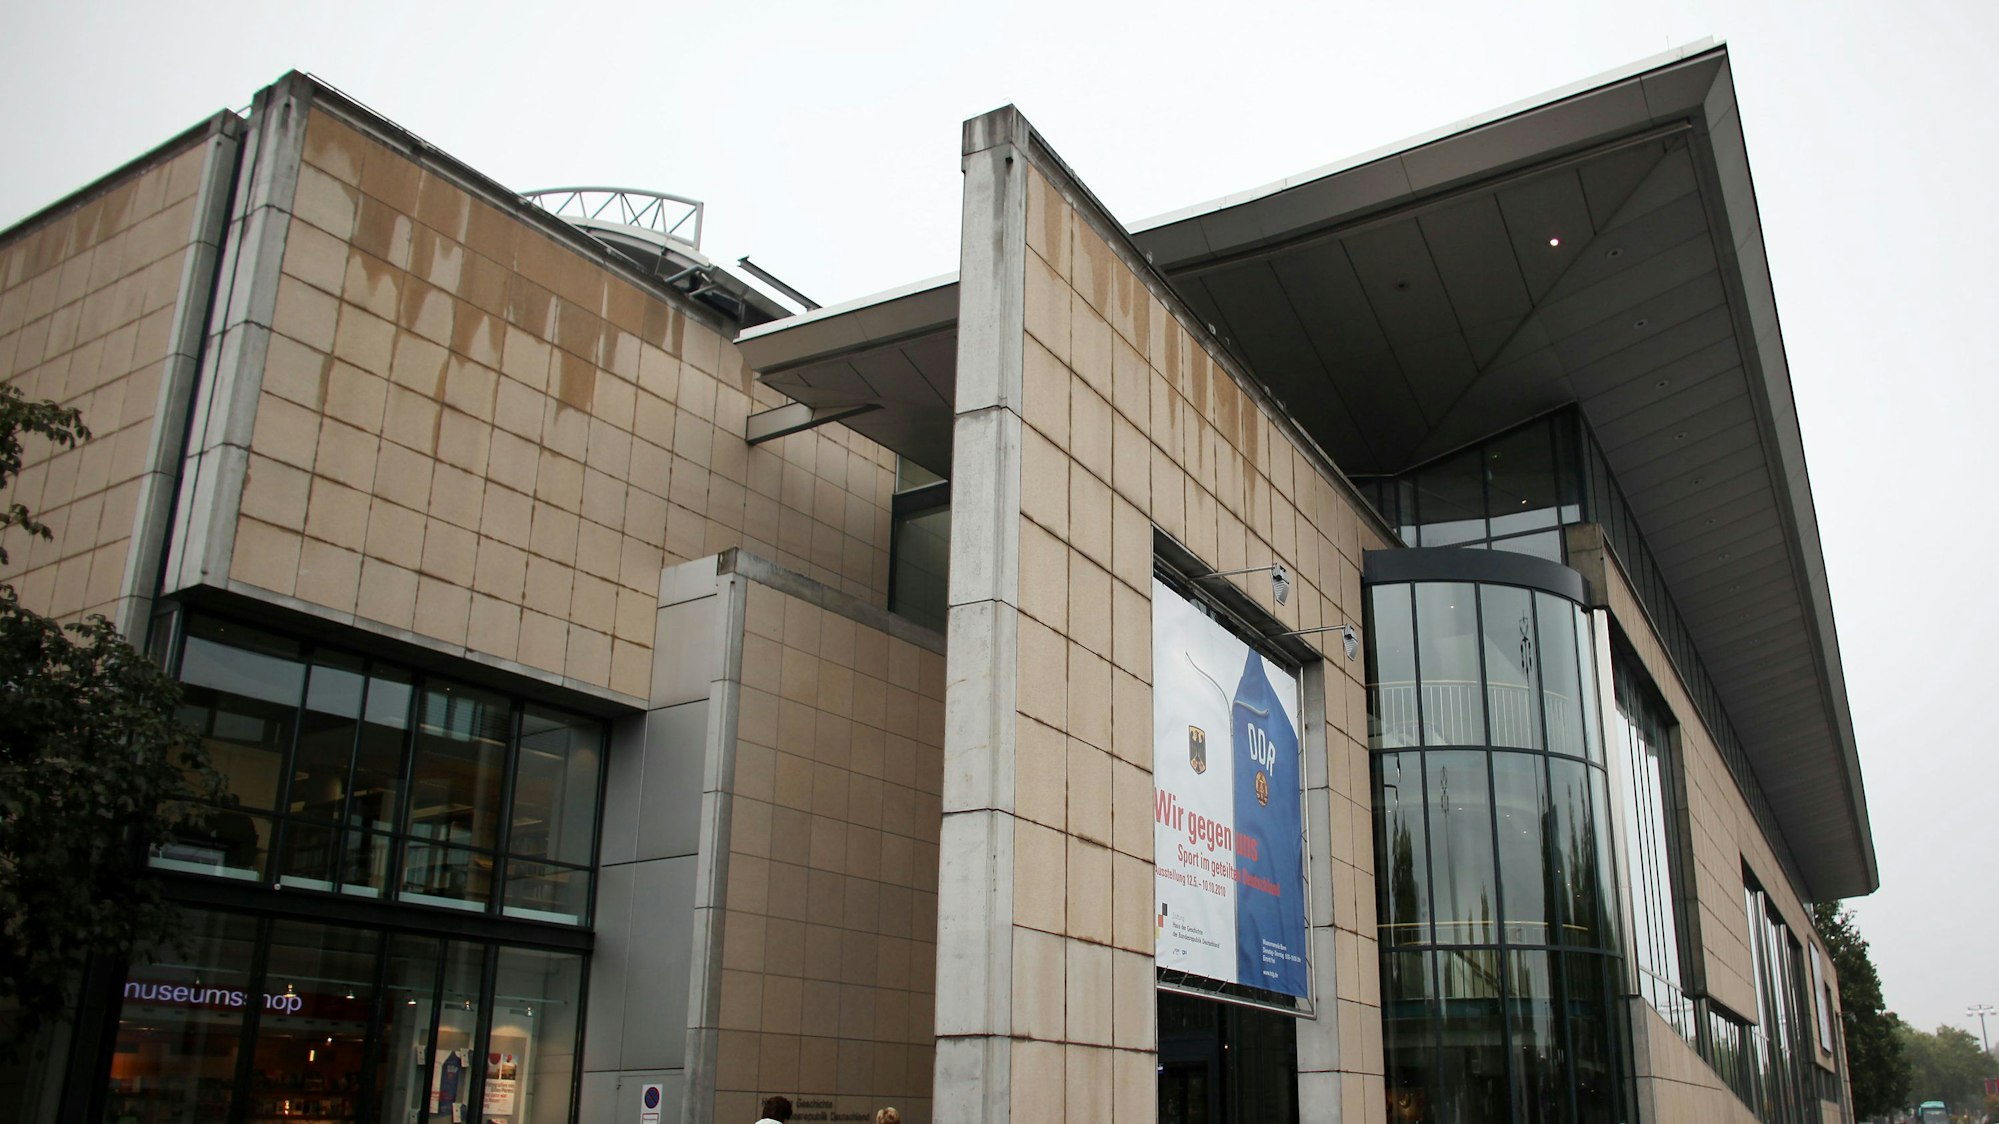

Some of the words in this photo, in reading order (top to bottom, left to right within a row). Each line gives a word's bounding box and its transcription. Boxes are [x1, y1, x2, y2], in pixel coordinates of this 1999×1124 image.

[1247, 722, 1276, 777] DDR
[1154, 786, 1184, 831] Wir
[1188, 811, 1232, 852] gegen
[1235, 831, 1258, 863] uns
[1178, 843, 1199, 868] Sport
[1200, 852, 1210, 872] im
[123, 981, 303, 1015] museumsop
